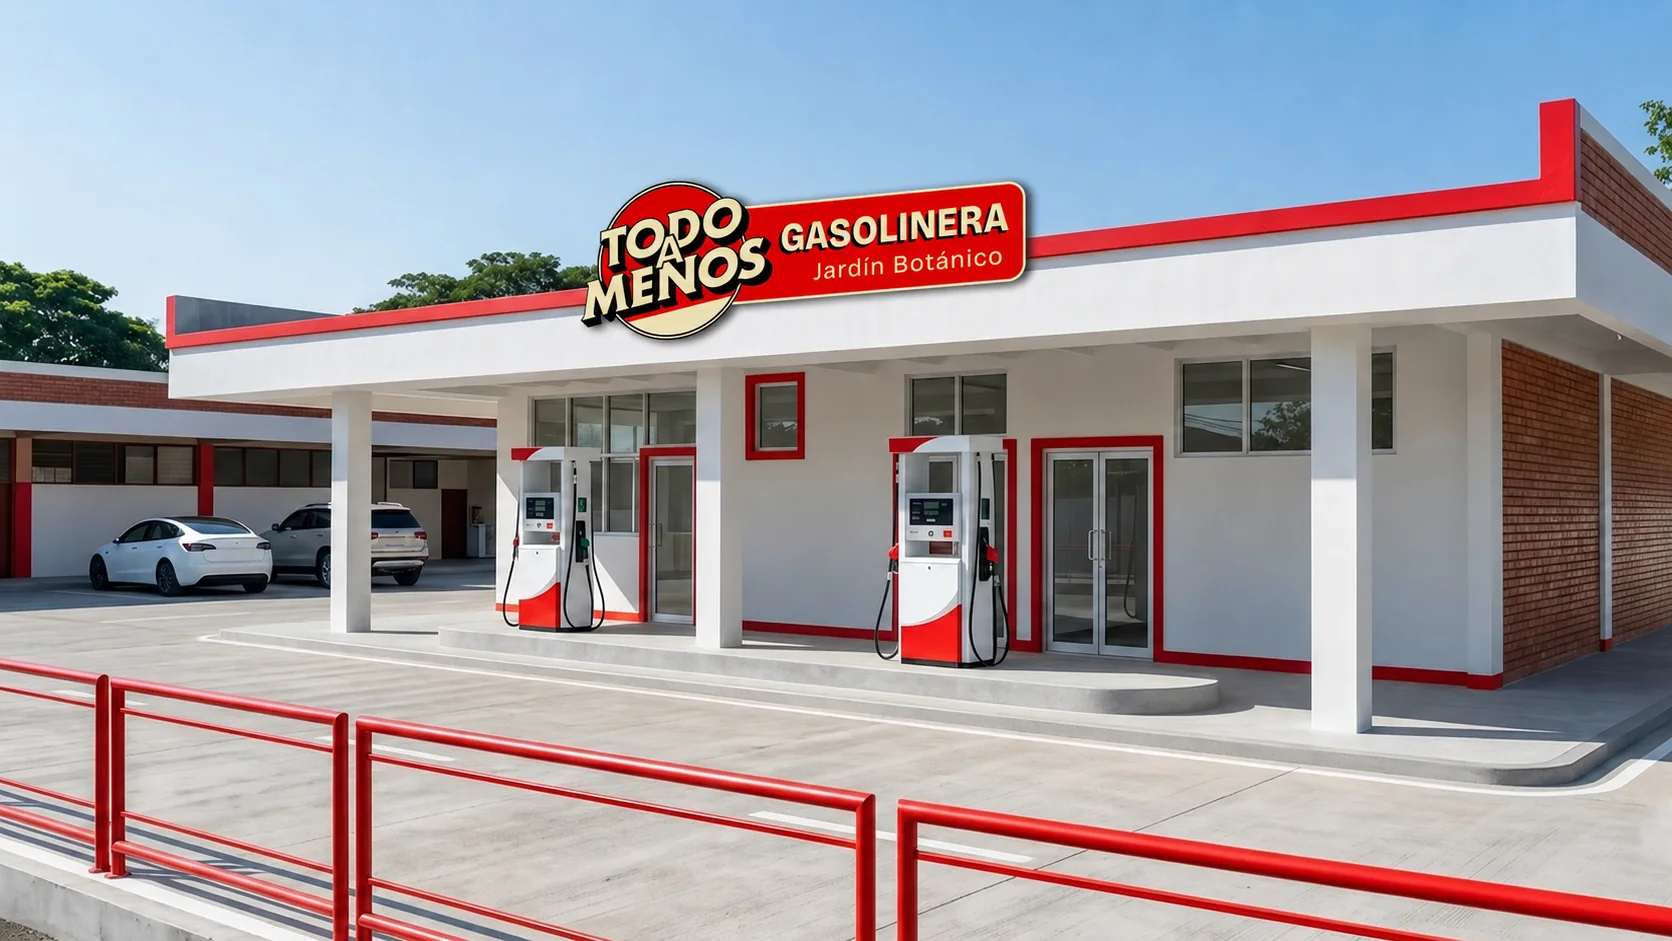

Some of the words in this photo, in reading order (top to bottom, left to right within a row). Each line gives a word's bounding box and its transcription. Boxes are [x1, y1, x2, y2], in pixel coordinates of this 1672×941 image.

[600, 197, 744, 268] TODO
[780, 203, 1009, 251] GASOLINERA
[656, 235, 684, 269] A
[813, 257, 884, 282] Jardín
[894, 249, 1003, 275] Botánico
[581, 237, 767, 321] MENOS
